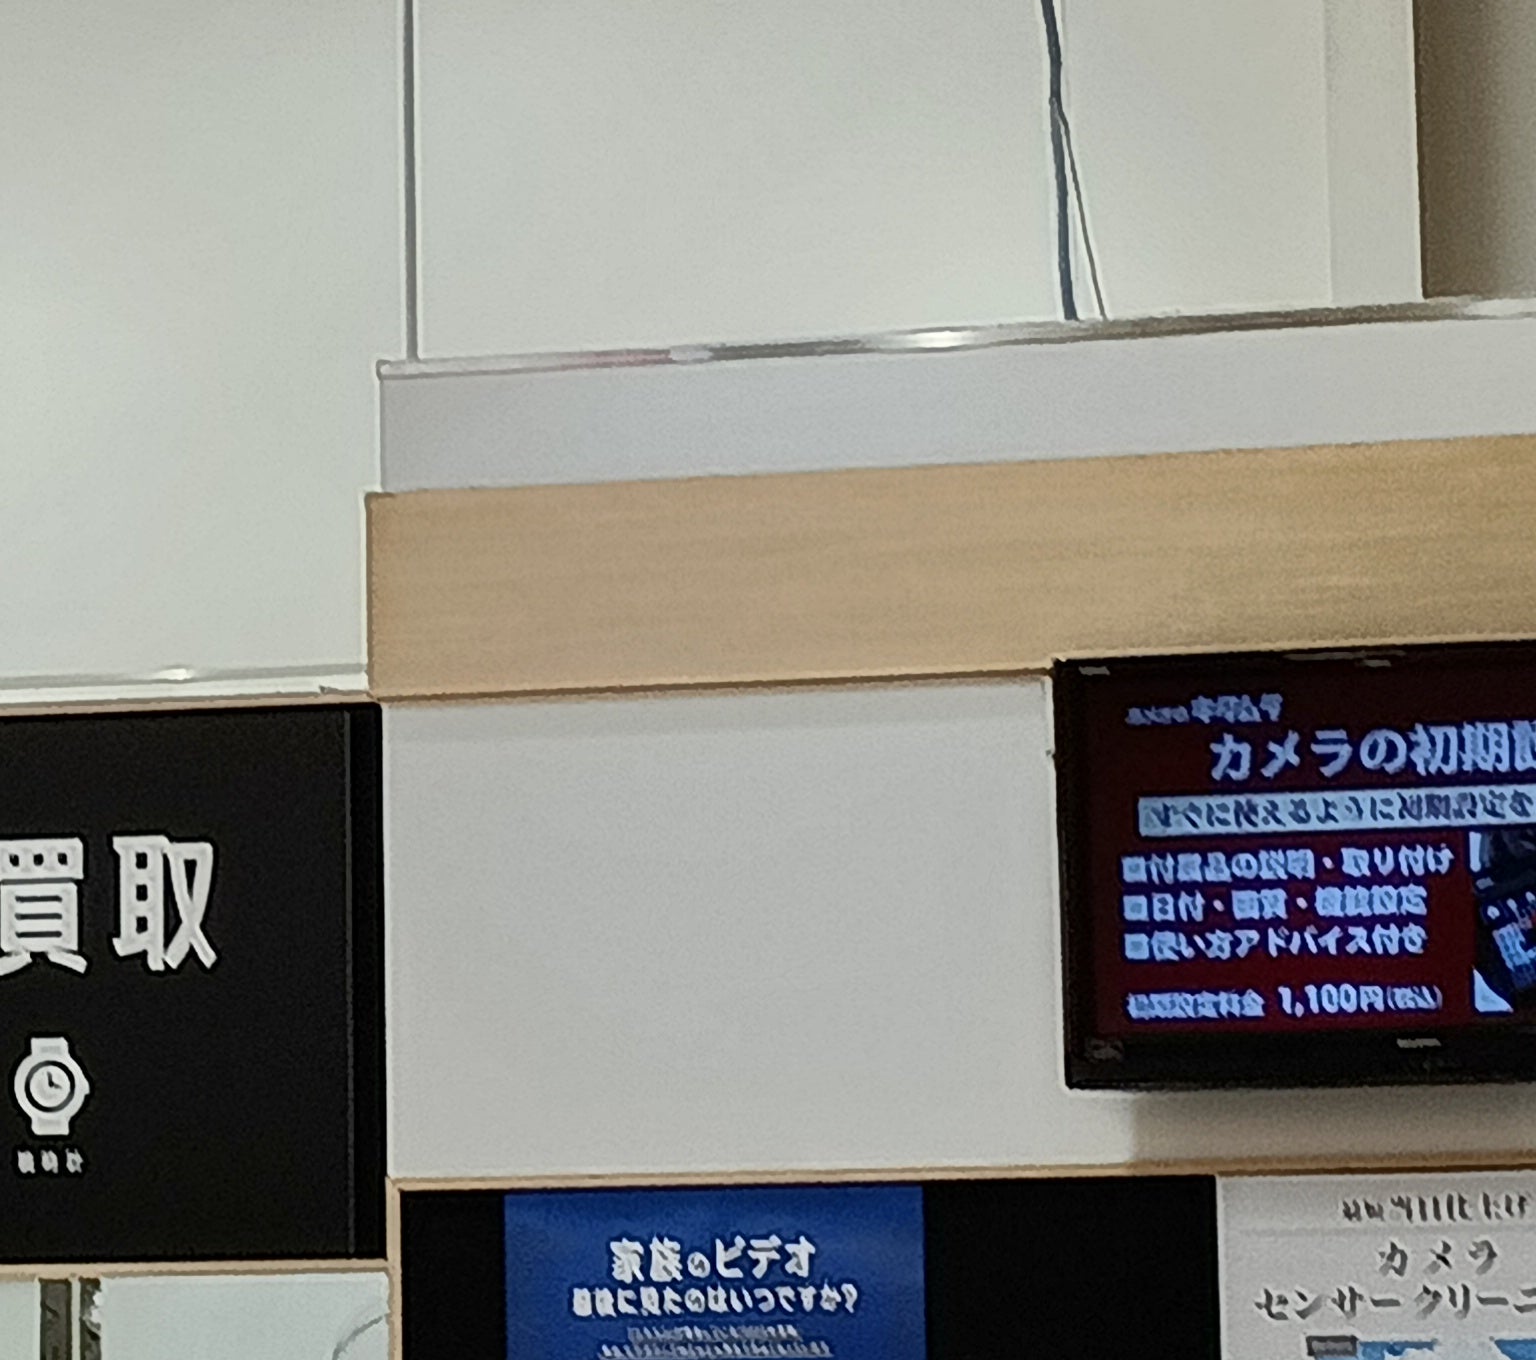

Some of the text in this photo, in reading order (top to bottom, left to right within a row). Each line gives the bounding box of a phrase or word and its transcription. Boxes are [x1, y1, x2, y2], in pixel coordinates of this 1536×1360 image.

[609, 1234, 816, 1284] 家族のビデオ
